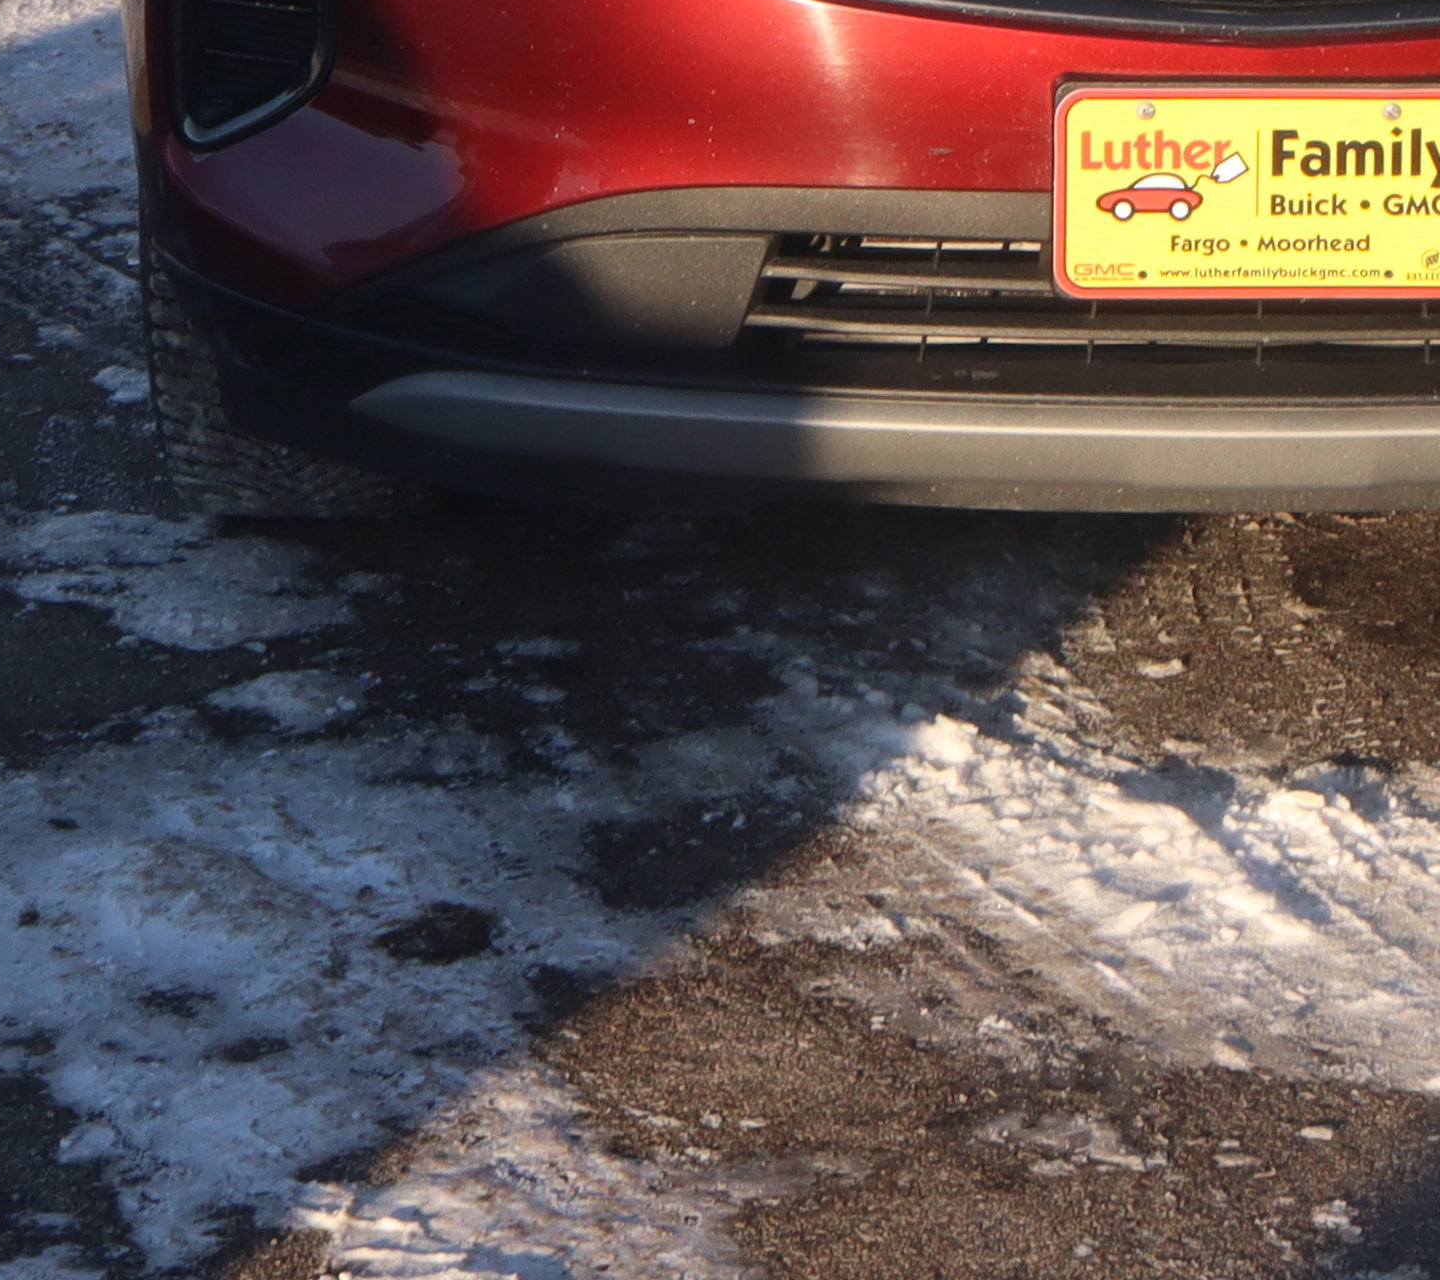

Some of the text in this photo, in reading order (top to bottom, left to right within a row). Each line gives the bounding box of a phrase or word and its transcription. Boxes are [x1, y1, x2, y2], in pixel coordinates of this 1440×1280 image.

[1080, 129, 1232, 171] Luther
[1270, 193, 1348, 216] Buick
[1170, 234, 1371, 256] Fargo Moorhead
[1073, 263, 1135, 276] GMC
[1159, 266, 1381, 280] www.lutherfamilybuickgmc.com
